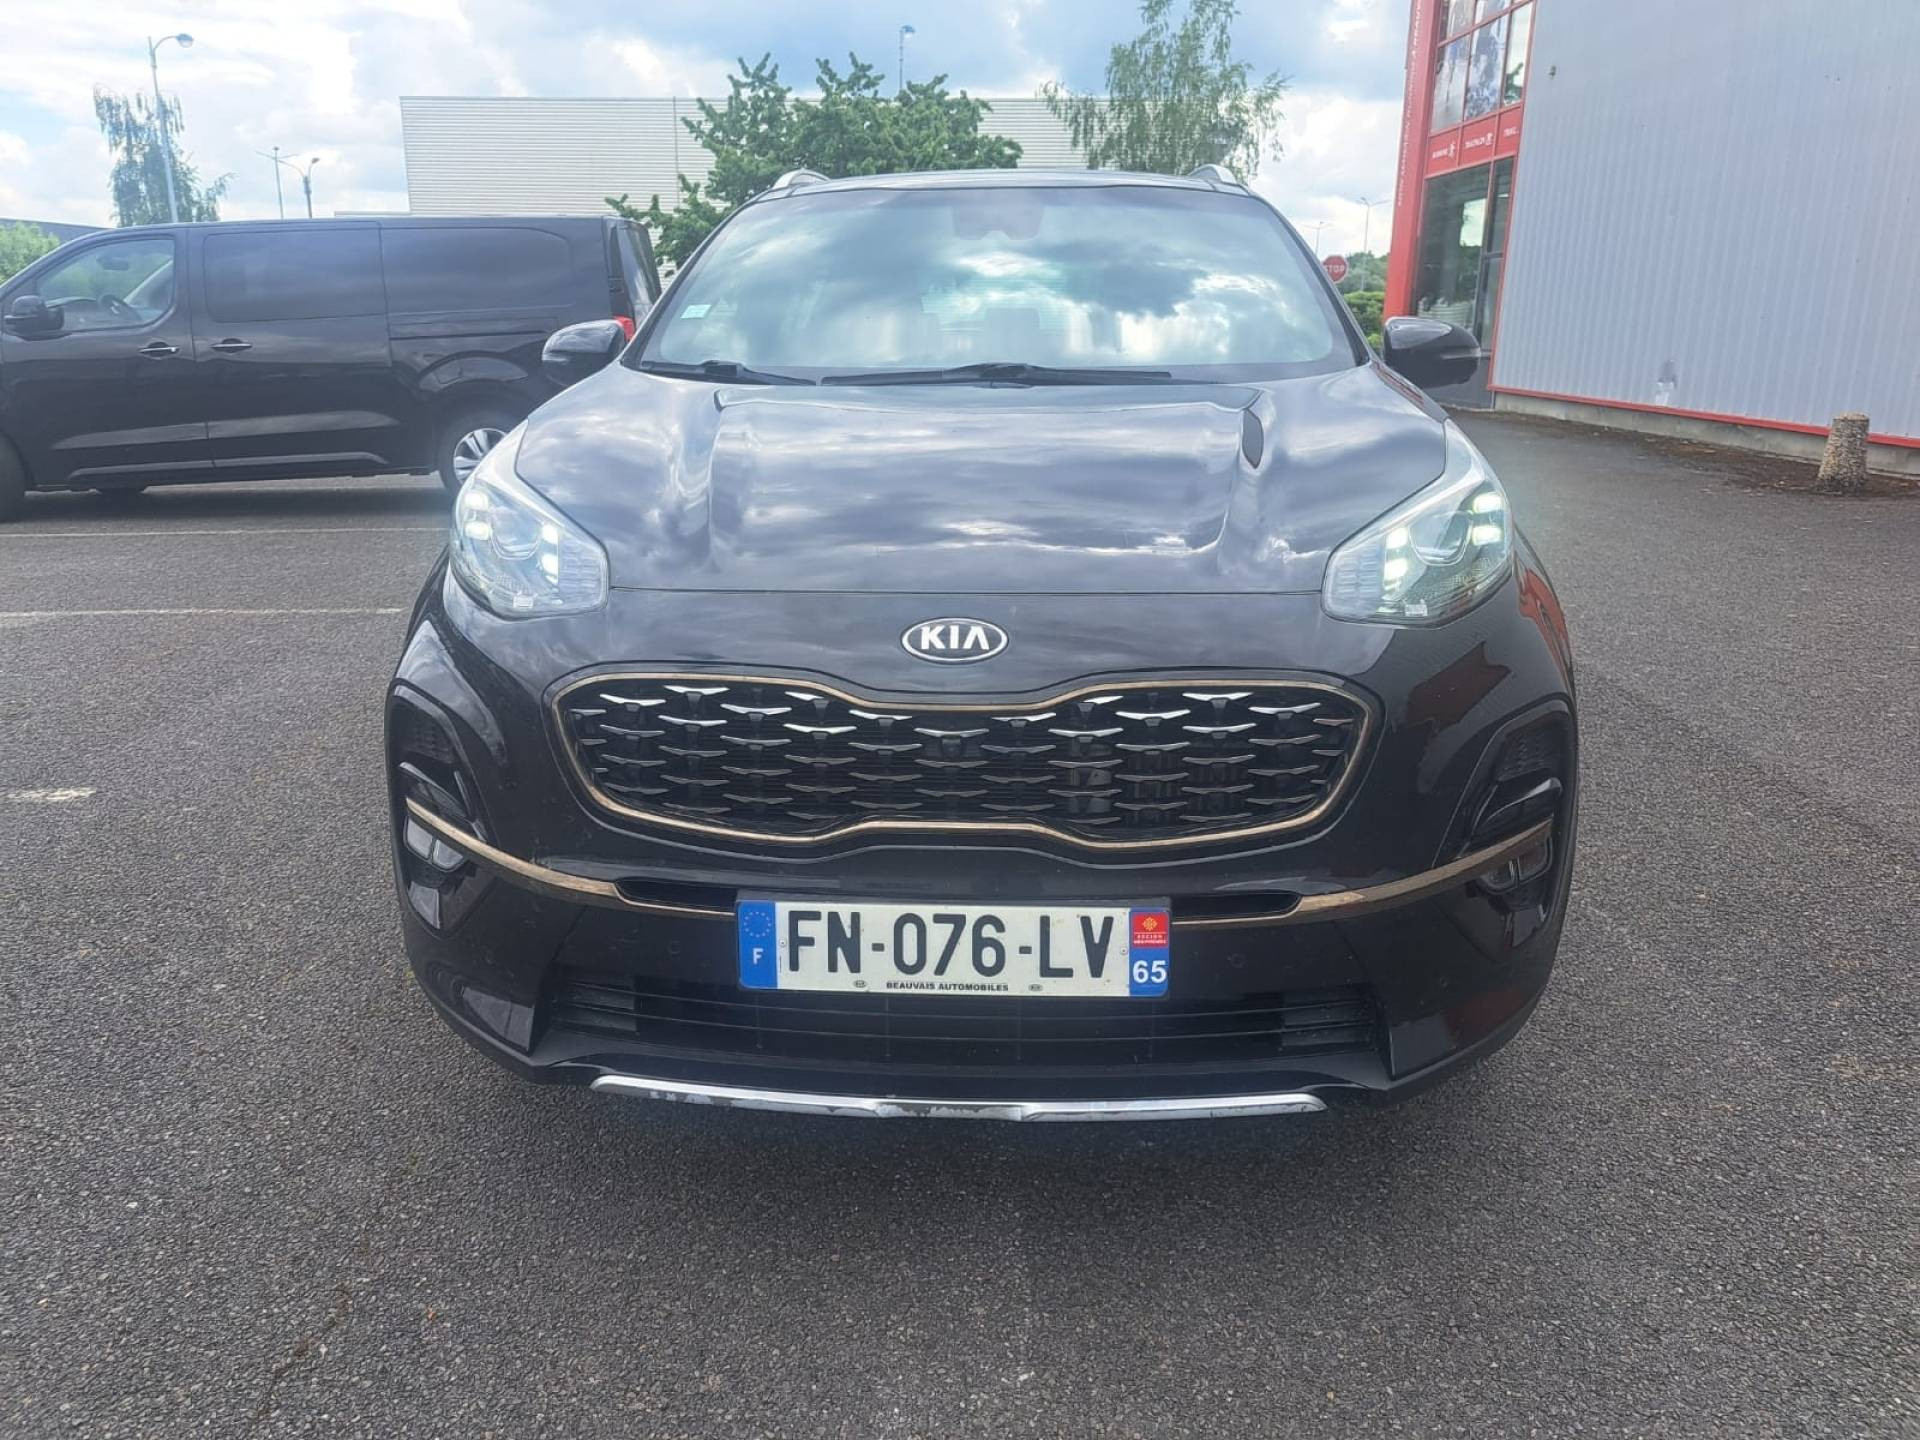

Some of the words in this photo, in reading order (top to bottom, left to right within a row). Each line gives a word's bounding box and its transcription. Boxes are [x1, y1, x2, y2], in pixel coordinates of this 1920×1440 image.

[921, 625, 990, 650] KIA
[752, 947, 764, 965] F
[788, 910, 1115, 979] FN-076-LV
[1132, 959, 1168, 984] 65
[886, 981, 935, 991] BEAUVAIS
[938, 982, 1009, 992] AUTOMOBILES
